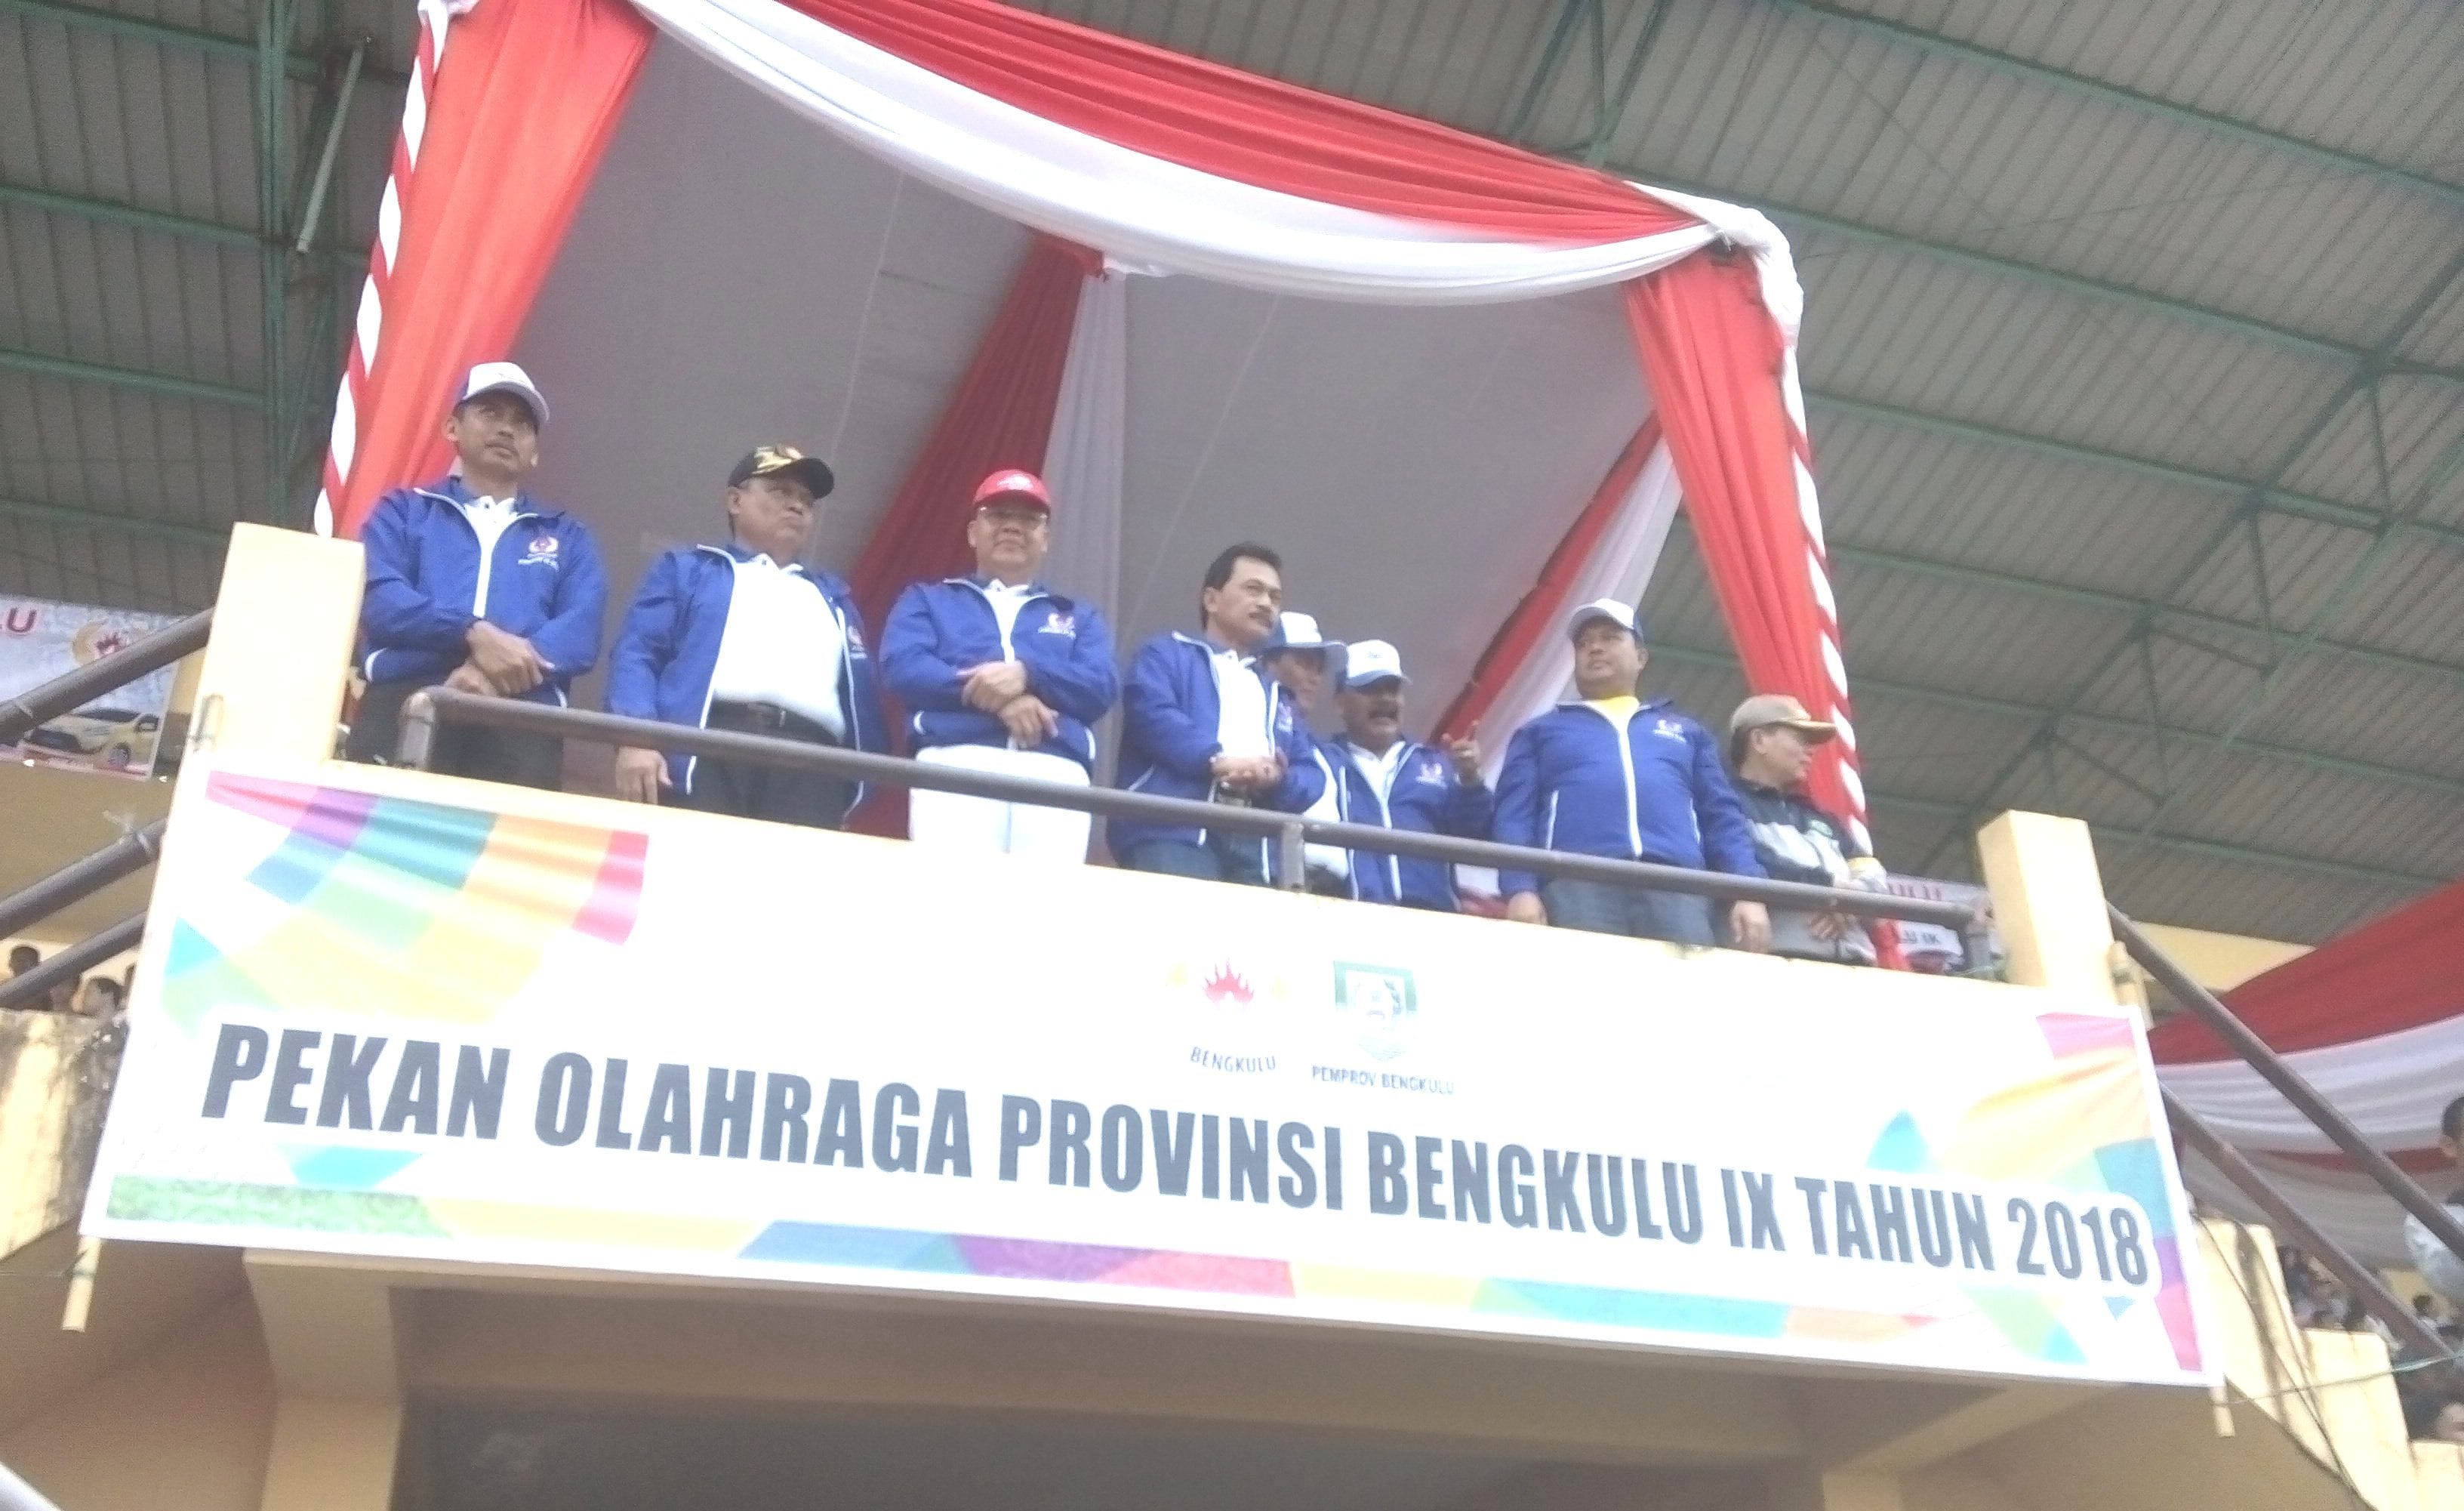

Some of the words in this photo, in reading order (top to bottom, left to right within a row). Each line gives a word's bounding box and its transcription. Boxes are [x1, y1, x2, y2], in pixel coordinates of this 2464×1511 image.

[1190, 1045, 1277, 1073] BENGKULU
[1311, 1065, 1376, 1087] PEMPROV
[1381, 1073, 1455, 1096] BENGKULU
[200, 1022, 511, 1140] PEKAN
[534, 1051, 972, 1179] OLAHRAGA
[998, 1093, 1343, 1211] PROVINSI
[1366, 1130, 1703, 1245] BENGKULU
[1720, 1167, 1786, 1252] IX
[1794, 1176, 1995, 1272] TAHUN
[2006, 1197, 2148, 1286] 2018
